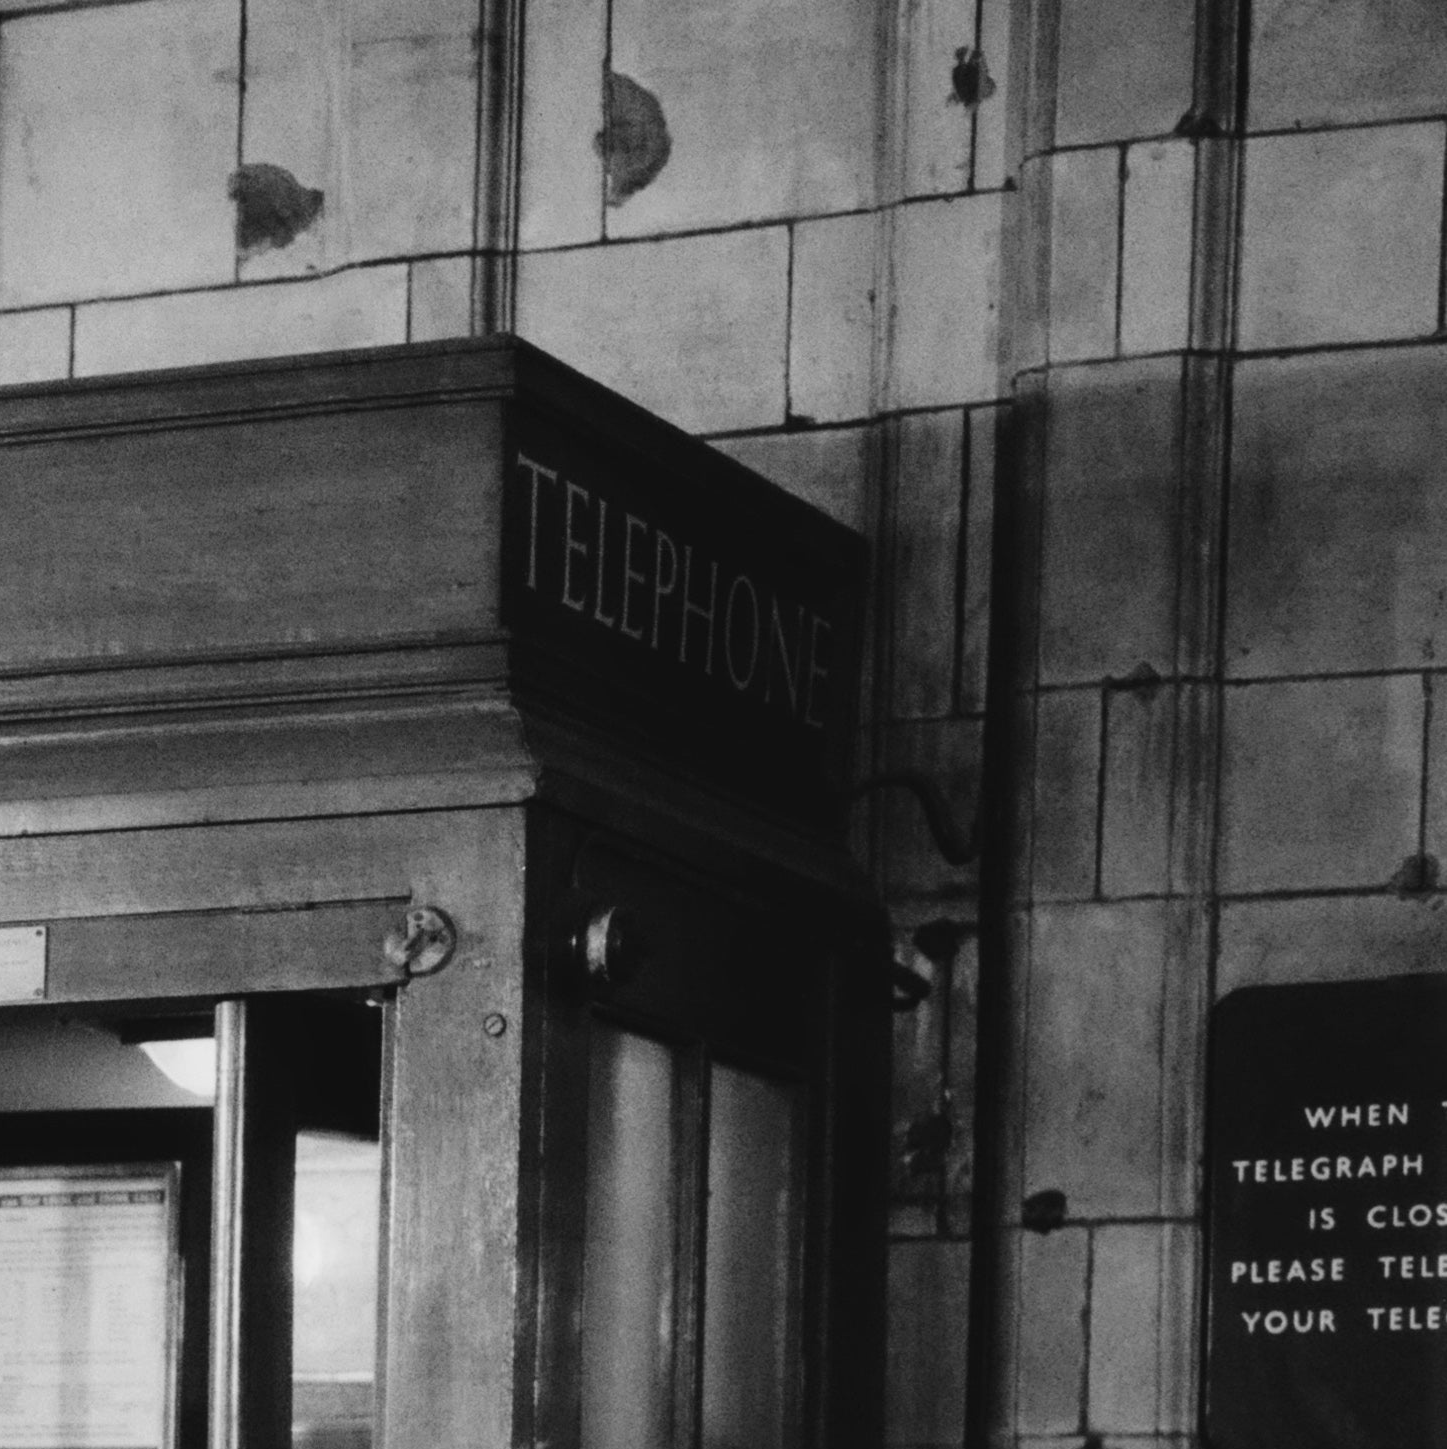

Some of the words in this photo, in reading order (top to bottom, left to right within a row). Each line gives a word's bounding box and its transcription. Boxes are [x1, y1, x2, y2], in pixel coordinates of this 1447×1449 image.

[517, 450, 832, 729] TELEPHONE
[1305, 1103, 1408, 1128] WHEN
[1232, 1154, 1423, 1183] TELEGRAPH
[1309, 1207, 1335, 1230] IS
[1231, 1258, 1345, 1284] PLEASE
[1241, 1310, 1336, 1334] YOUR
[1367, 1306, 1447, 1331] TELE
